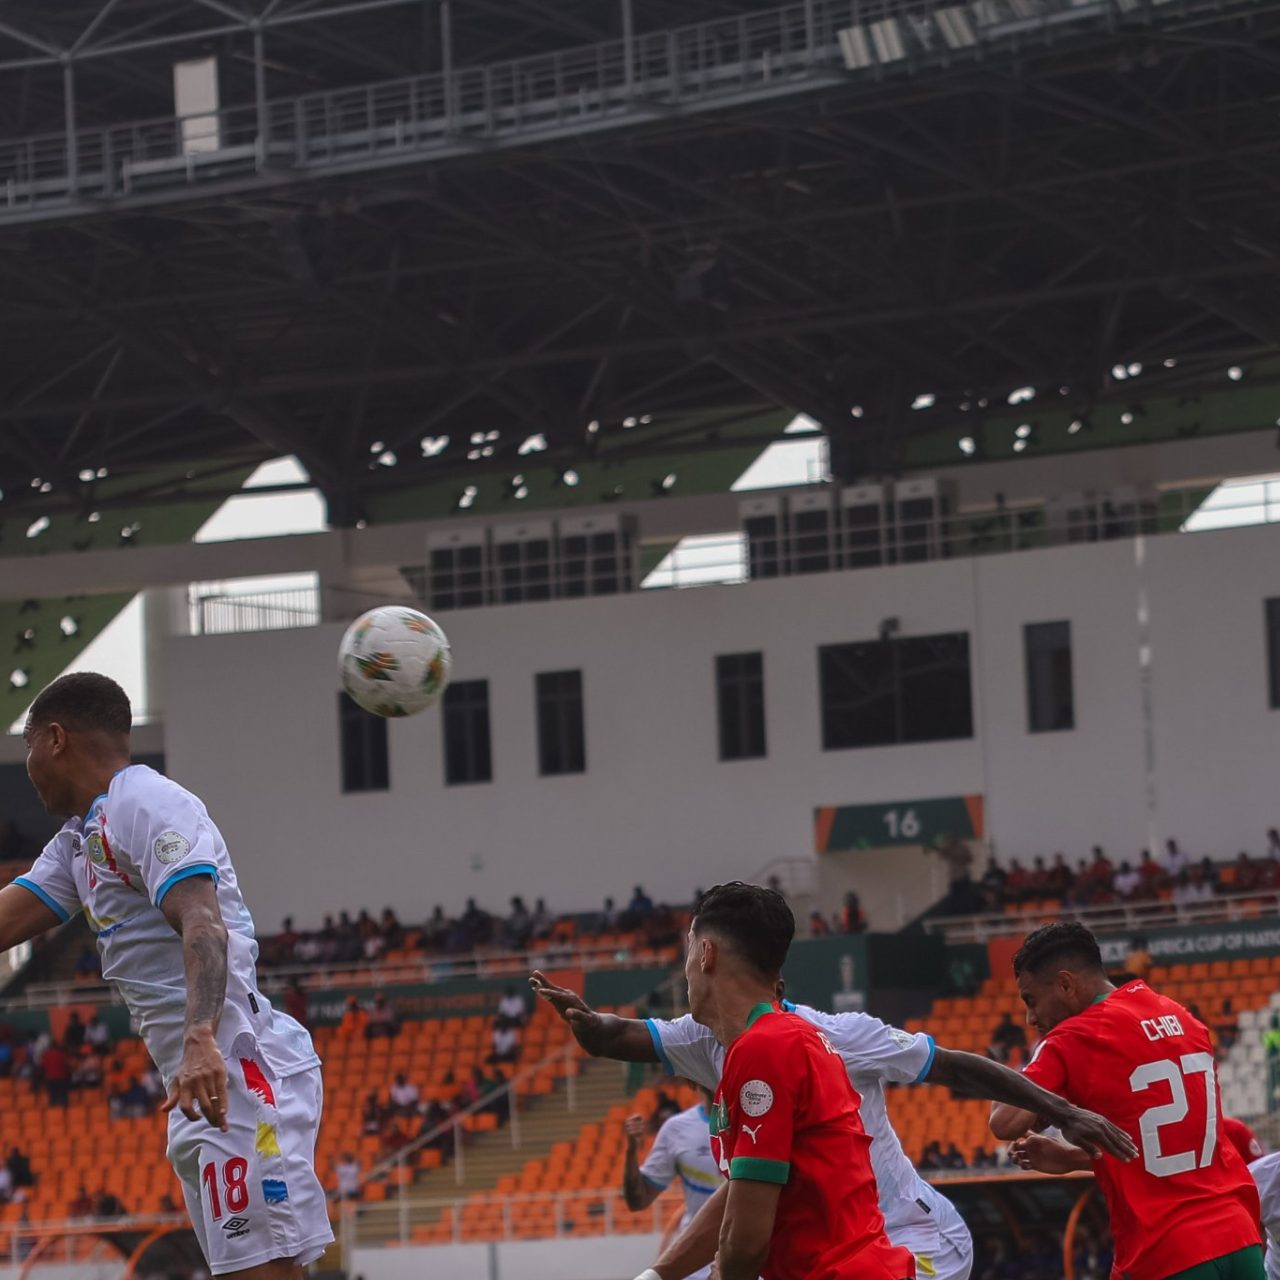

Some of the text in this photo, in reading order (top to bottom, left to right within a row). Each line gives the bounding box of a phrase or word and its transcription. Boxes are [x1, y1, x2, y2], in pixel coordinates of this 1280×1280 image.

[883, 808, 921, 838] 16
[1140, 1014, 1185, 1042] CHIBI
[1129, 1051, 1217, 1178] 27
[202, 1156, 250, 1222] 18
